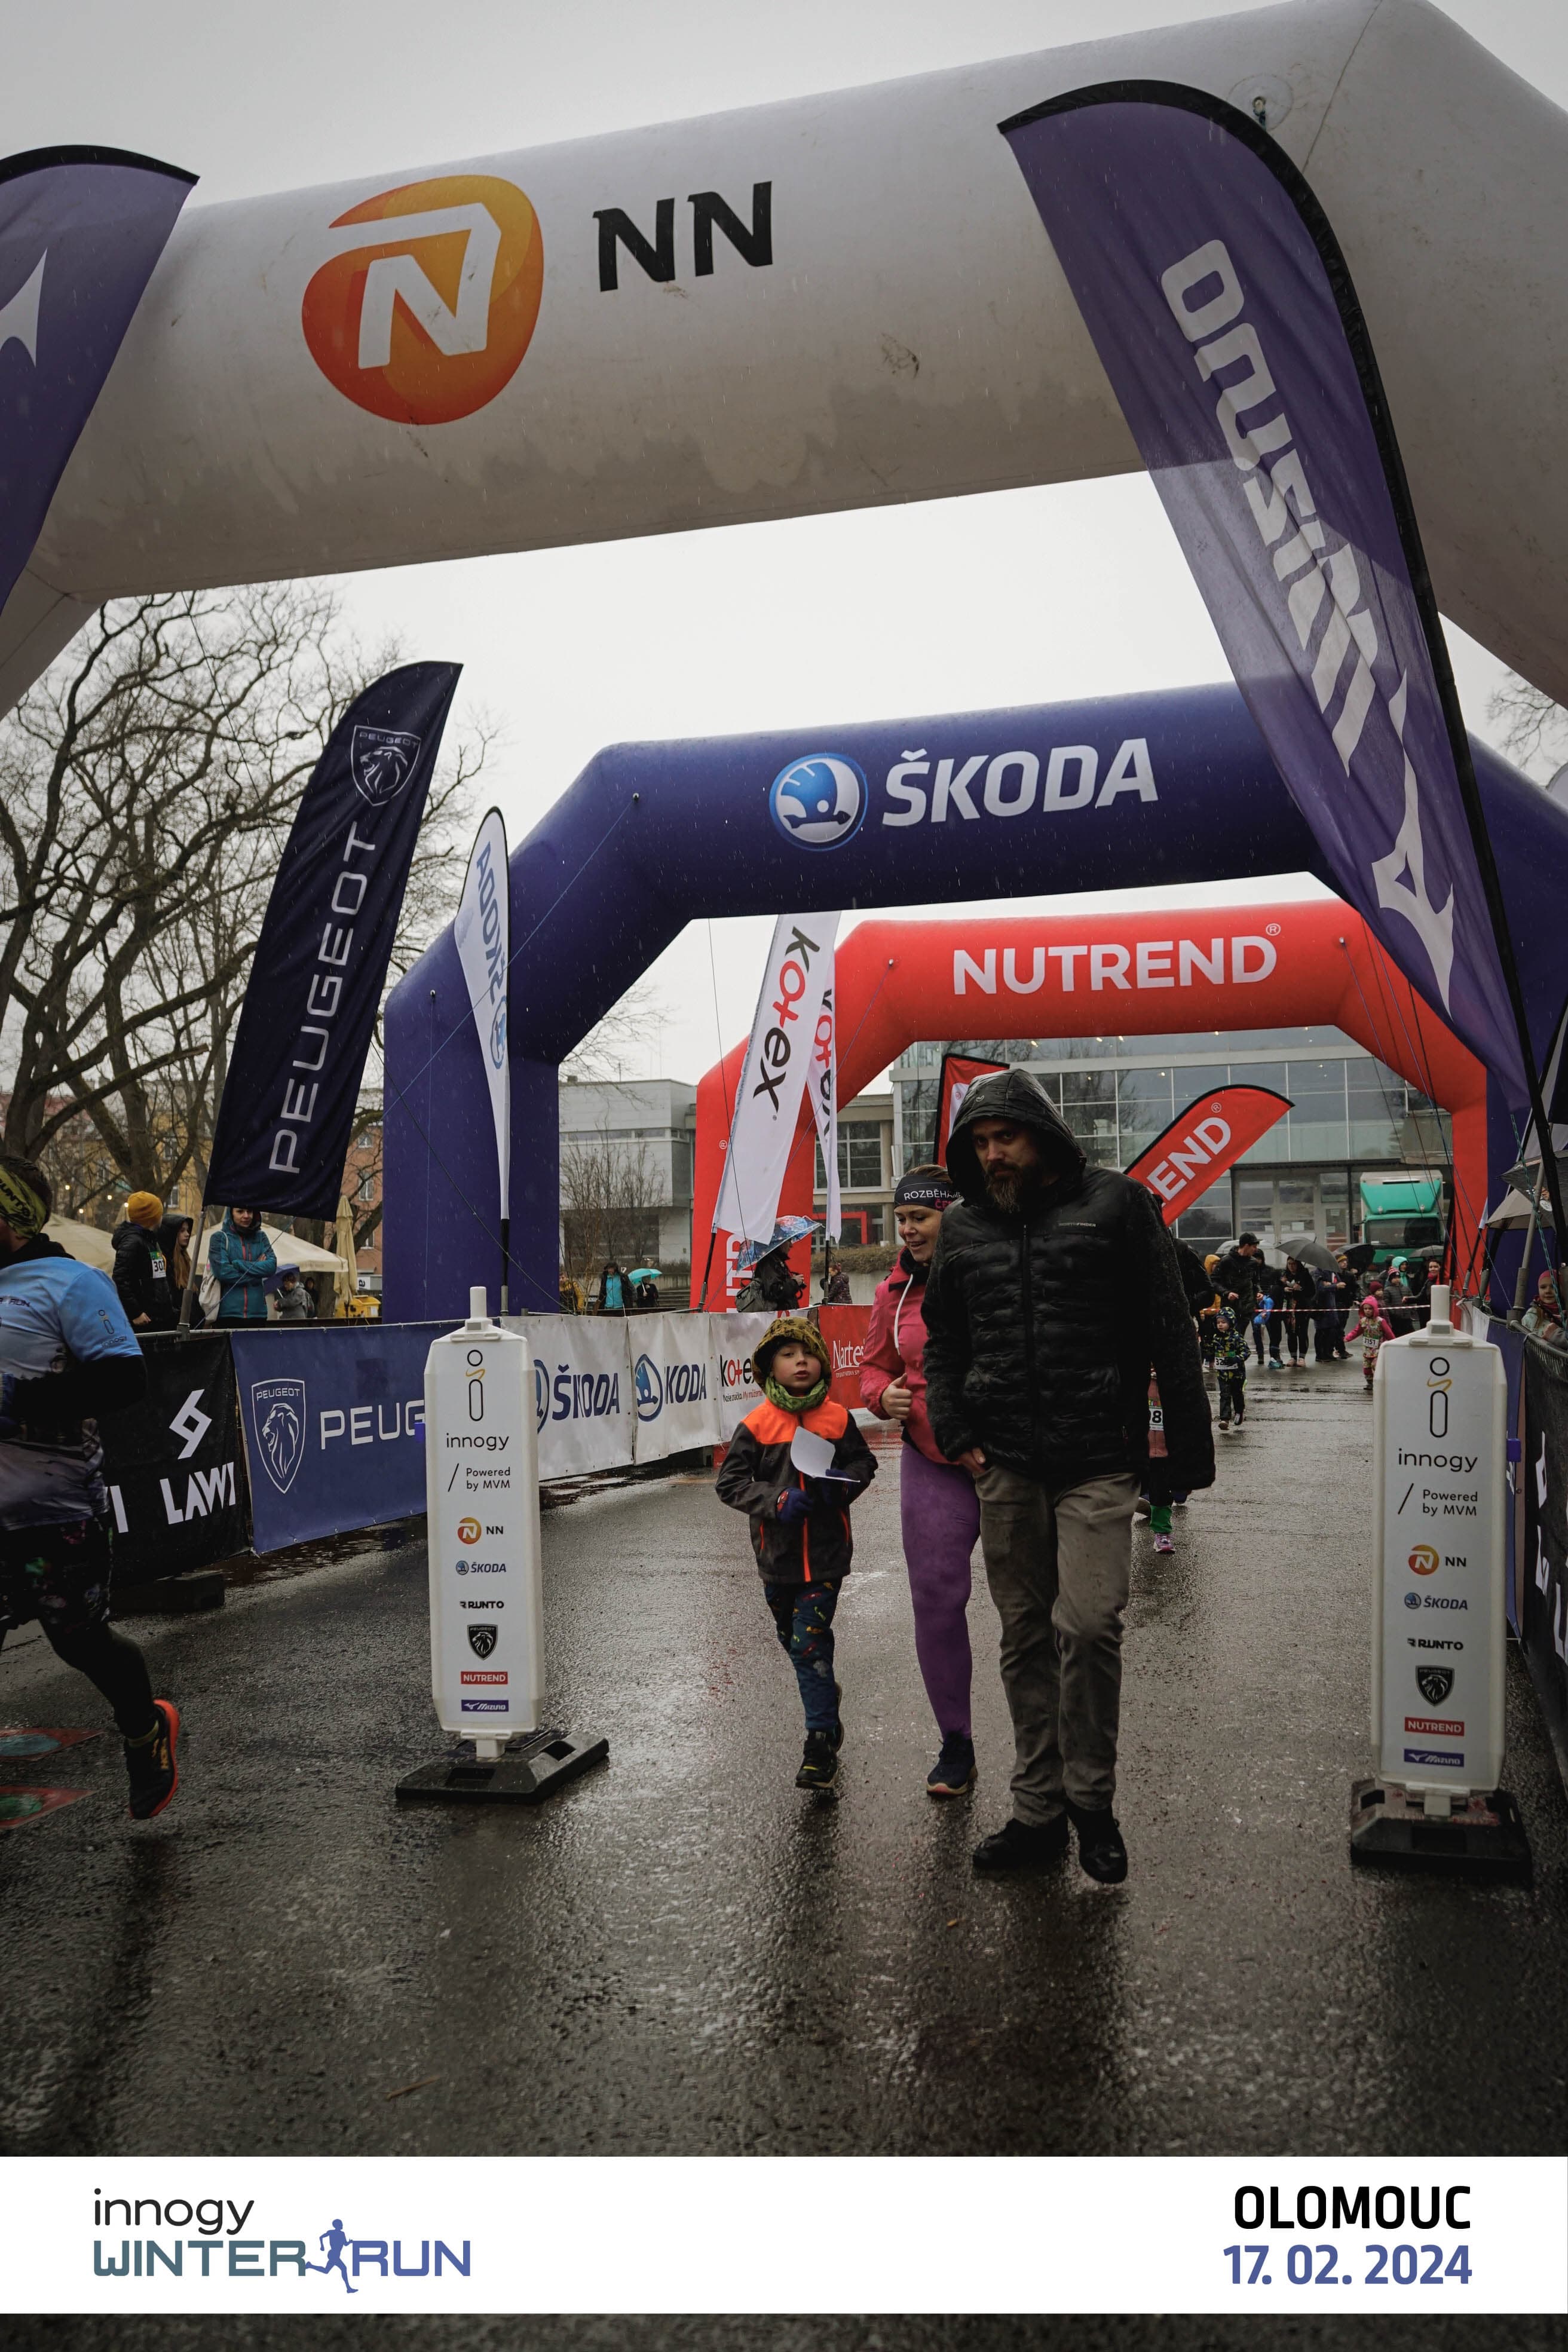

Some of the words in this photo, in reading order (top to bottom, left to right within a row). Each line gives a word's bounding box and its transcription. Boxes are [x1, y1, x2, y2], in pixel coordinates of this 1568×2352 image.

[592, 180, 773, 292] NN
[359, 731, 418, 748] PEUGEOT
[883, 738, 1158, 827] ŠKODA
[269, 821, 375, 1173] PEUGEOT
[719, 1355, 755, 1387] kote
[664, 1363, 707, 1404] KODA
[256, 1388, 300, 1401] PEUGEOT
[552, 1364, 620, 1421] ŠKODA
[446, 1432, 509, 1451] innogy
[1398, 1448, 1478, 1473] innogy
[466, 1466, 510, 1477] Powered
[160, 1462, 236, 1524] LAWI
[466, 1480, 478, 1492] by
[483, 1480, 510, 1489] MVM
[1423, 1489, 1478, 1502] Powered
[1423, 1503, 1438, 1517] by
[1444, 1505, 1477, 1516] MVM
[486, 1526, 504, 1535] NN
[470, 1562, 507, 1573] ŠKODA
[1445, 1556, 1466, 1567] NN
[1423, 1595, 1468, 1610] ŠKODA
[1418, 1639, 1463, 1650] RUNTO
[463, 1674, 506, 1682] NUTREND
[1408, 1720, 1462, 1733] NUTREND
